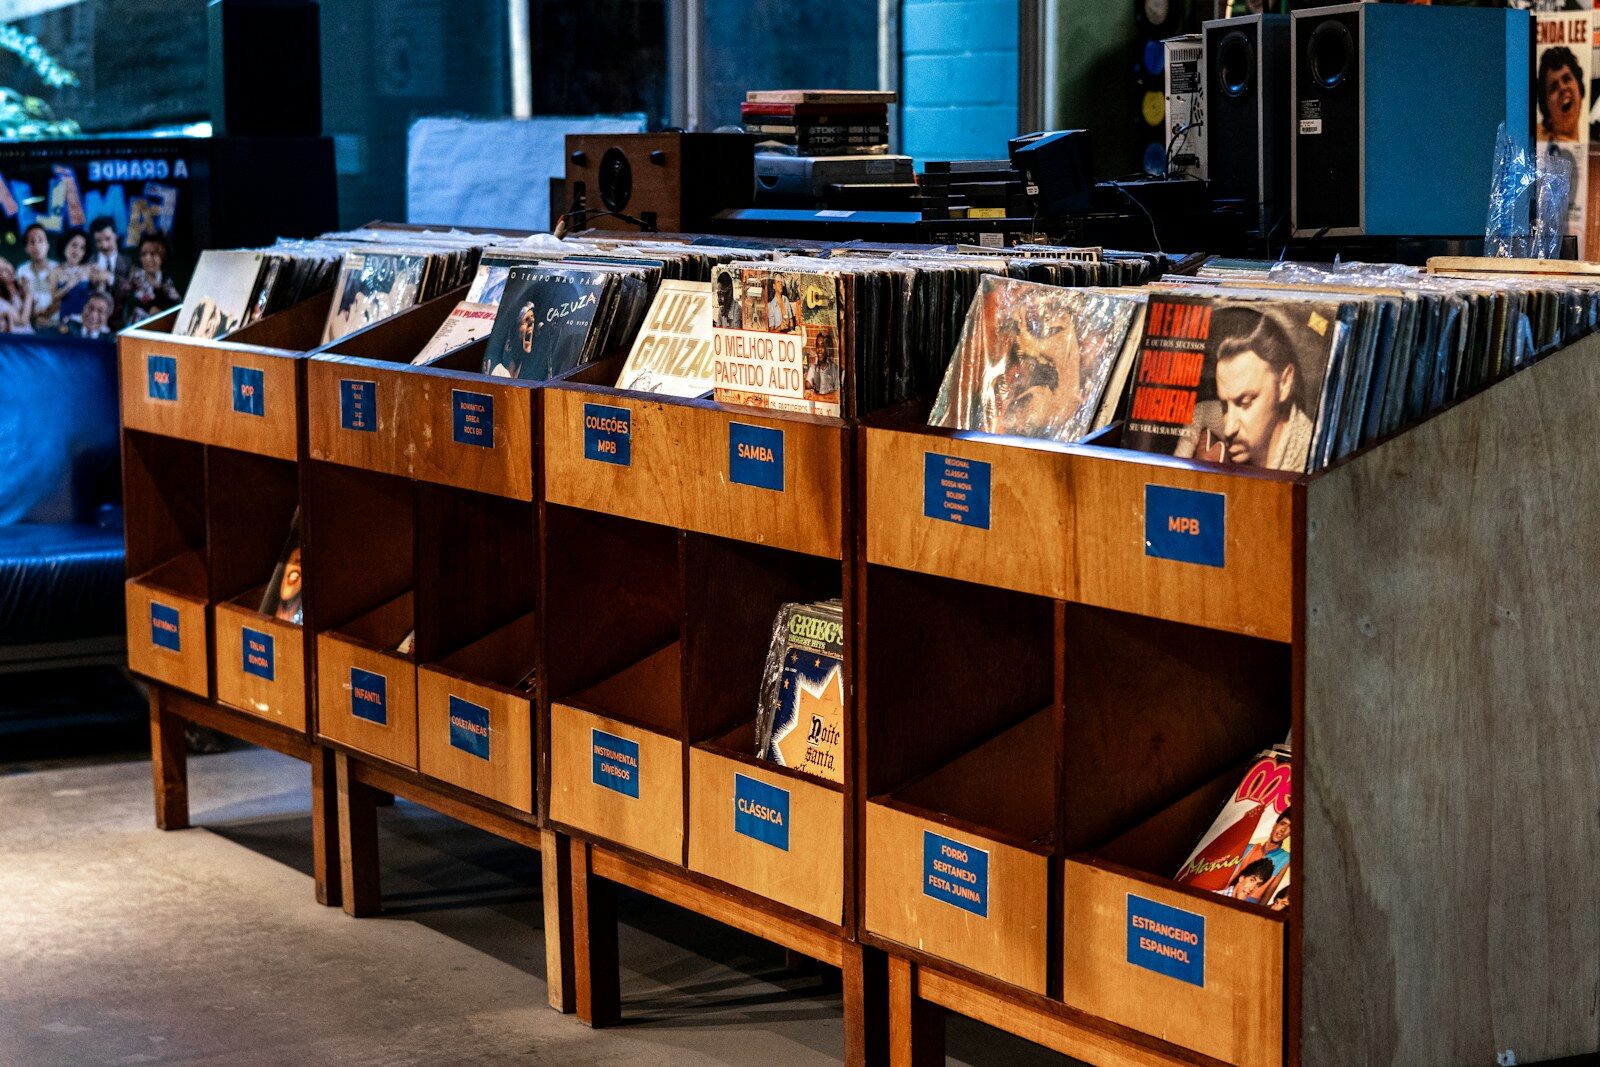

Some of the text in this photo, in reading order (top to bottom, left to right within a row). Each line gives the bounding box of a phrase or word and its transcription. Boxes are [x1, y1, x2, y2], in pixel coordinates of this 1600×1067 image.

[1536, 20, 1587, 43] ENDA LEE
[510, 272, 517, 280] O
[521, 272, 550, 283] TEMPO
[555, 275, 575, 284] NÃO
[546, 292, 597, 322] CAZUZA
[650, 292, 707, 334] LUIZ
[1147, 303, 1212, 340] MENINA
[714, 333, 795, 363] O MELHOR DO
[1145, 338, 1206, 350] E OUTROS SUCESSOS
[154, 371, 169, 384] ROCK
[715, 361, 801, 391] PARTIDO ALTO
[1138, 350, 1204, 387] PAULINHO
[241, 384, 254, 396] POP
[1131, 386, 1198, 424] NOGUEIRA
[586, 416, 629, 435] COLEÇÕES
[597, 439, 617, 454] MPB
[738, 443, 774, 463] SAMBA
[1168, 515, 1200, 536] MPB
[249, 640, 266, 653] TRILHA
[811, 641, 826, 650] HITS
[248, 653, 269, 668] SONORA
[354, 687, 382, 706] INFANTIL
[451, 715, 488, 737] COLETÂNEAS
[593, 745, 638, 768] INSTRUMENTAL
[601, 763, 630, 781] DIVERSOS
[738, 798, 783, 826] CLÁSSICA
[941, 845, 969, 864] FORRÓ
[933, 859, 977, 885] SERTANEJO
[1178, 855, 1243, 882] Mania
[928, 874, 981, 904] FESTA JUNINA
[1132, 915, 1199, 946] ESTRANGEIRO
[1140, 937, 1191, 964] ESPANHOL
